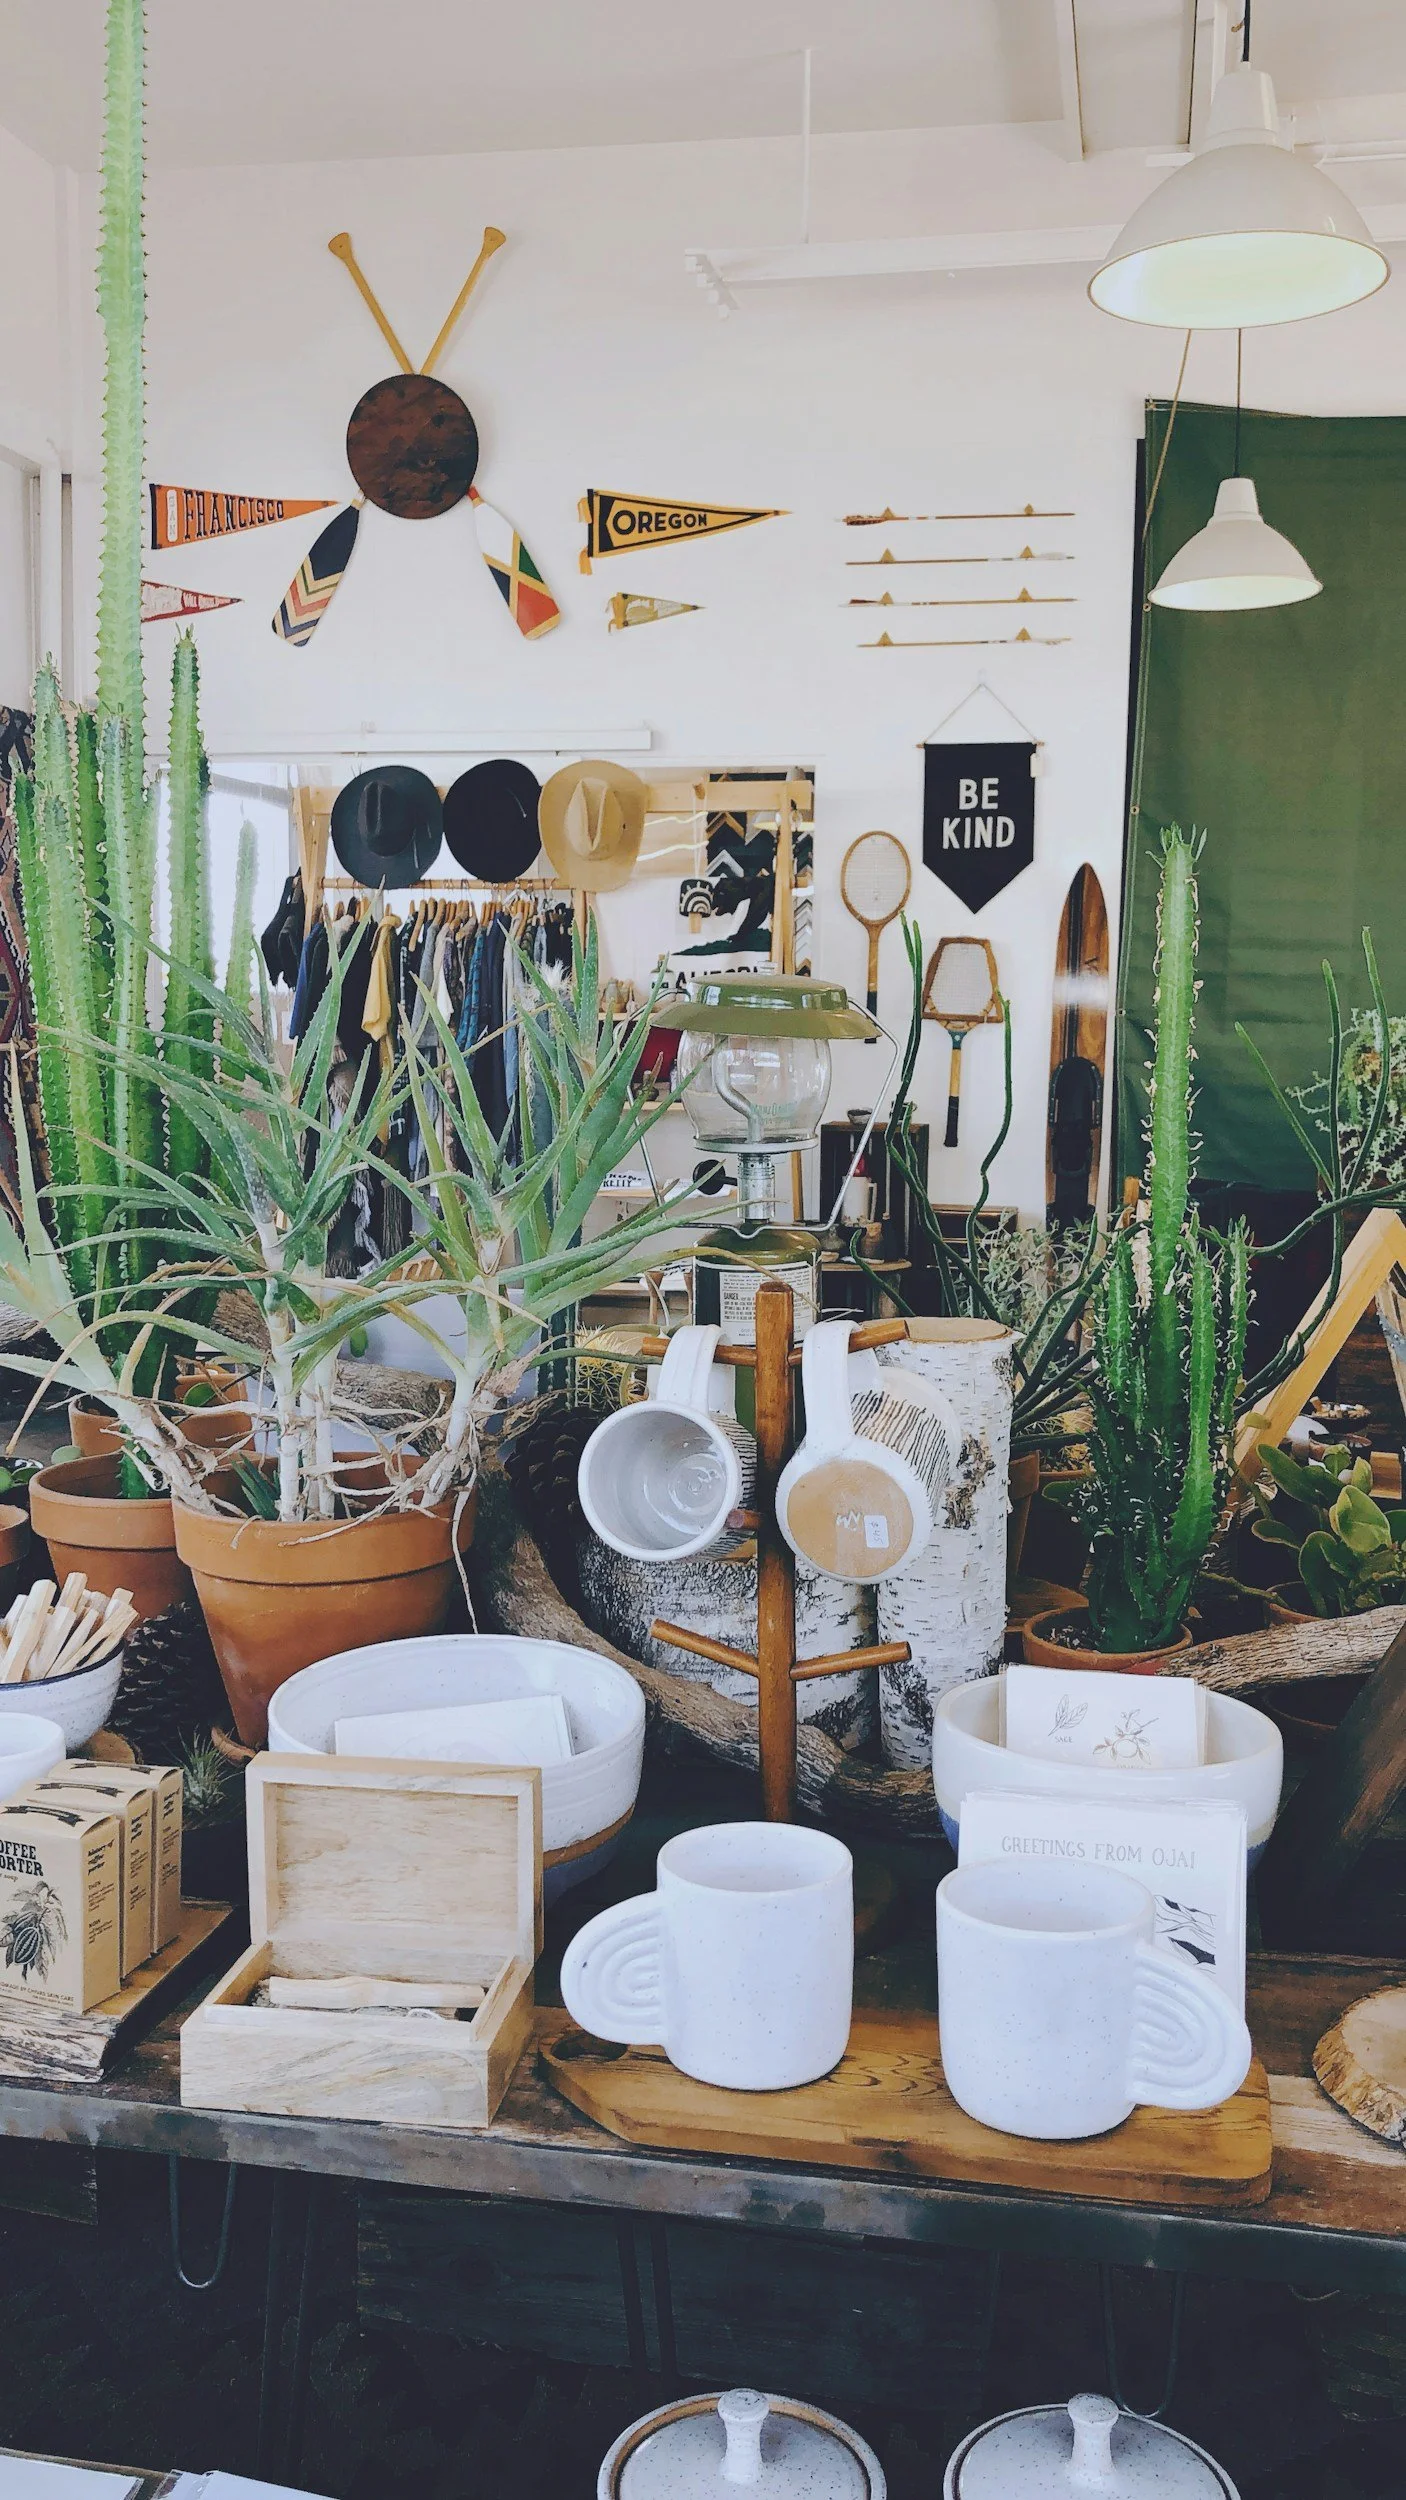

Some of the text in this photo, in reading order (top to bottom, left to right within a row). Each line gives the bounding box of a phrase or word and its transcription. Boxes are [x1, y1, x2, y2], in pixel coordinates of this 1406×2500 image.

[184, 489, 284, 540] FRANCISCO
[612, 509, 708, 535] OREGON
[959, 777, 999, 810] BE
[943, 816, 1015, 849] KIND
[0, 1839, 37, 1860] OFFEE
[0, 1855, 44, 1876] ORTER
[1001, 1836, 1196, 1869] GREETINGS FROM OJAI
